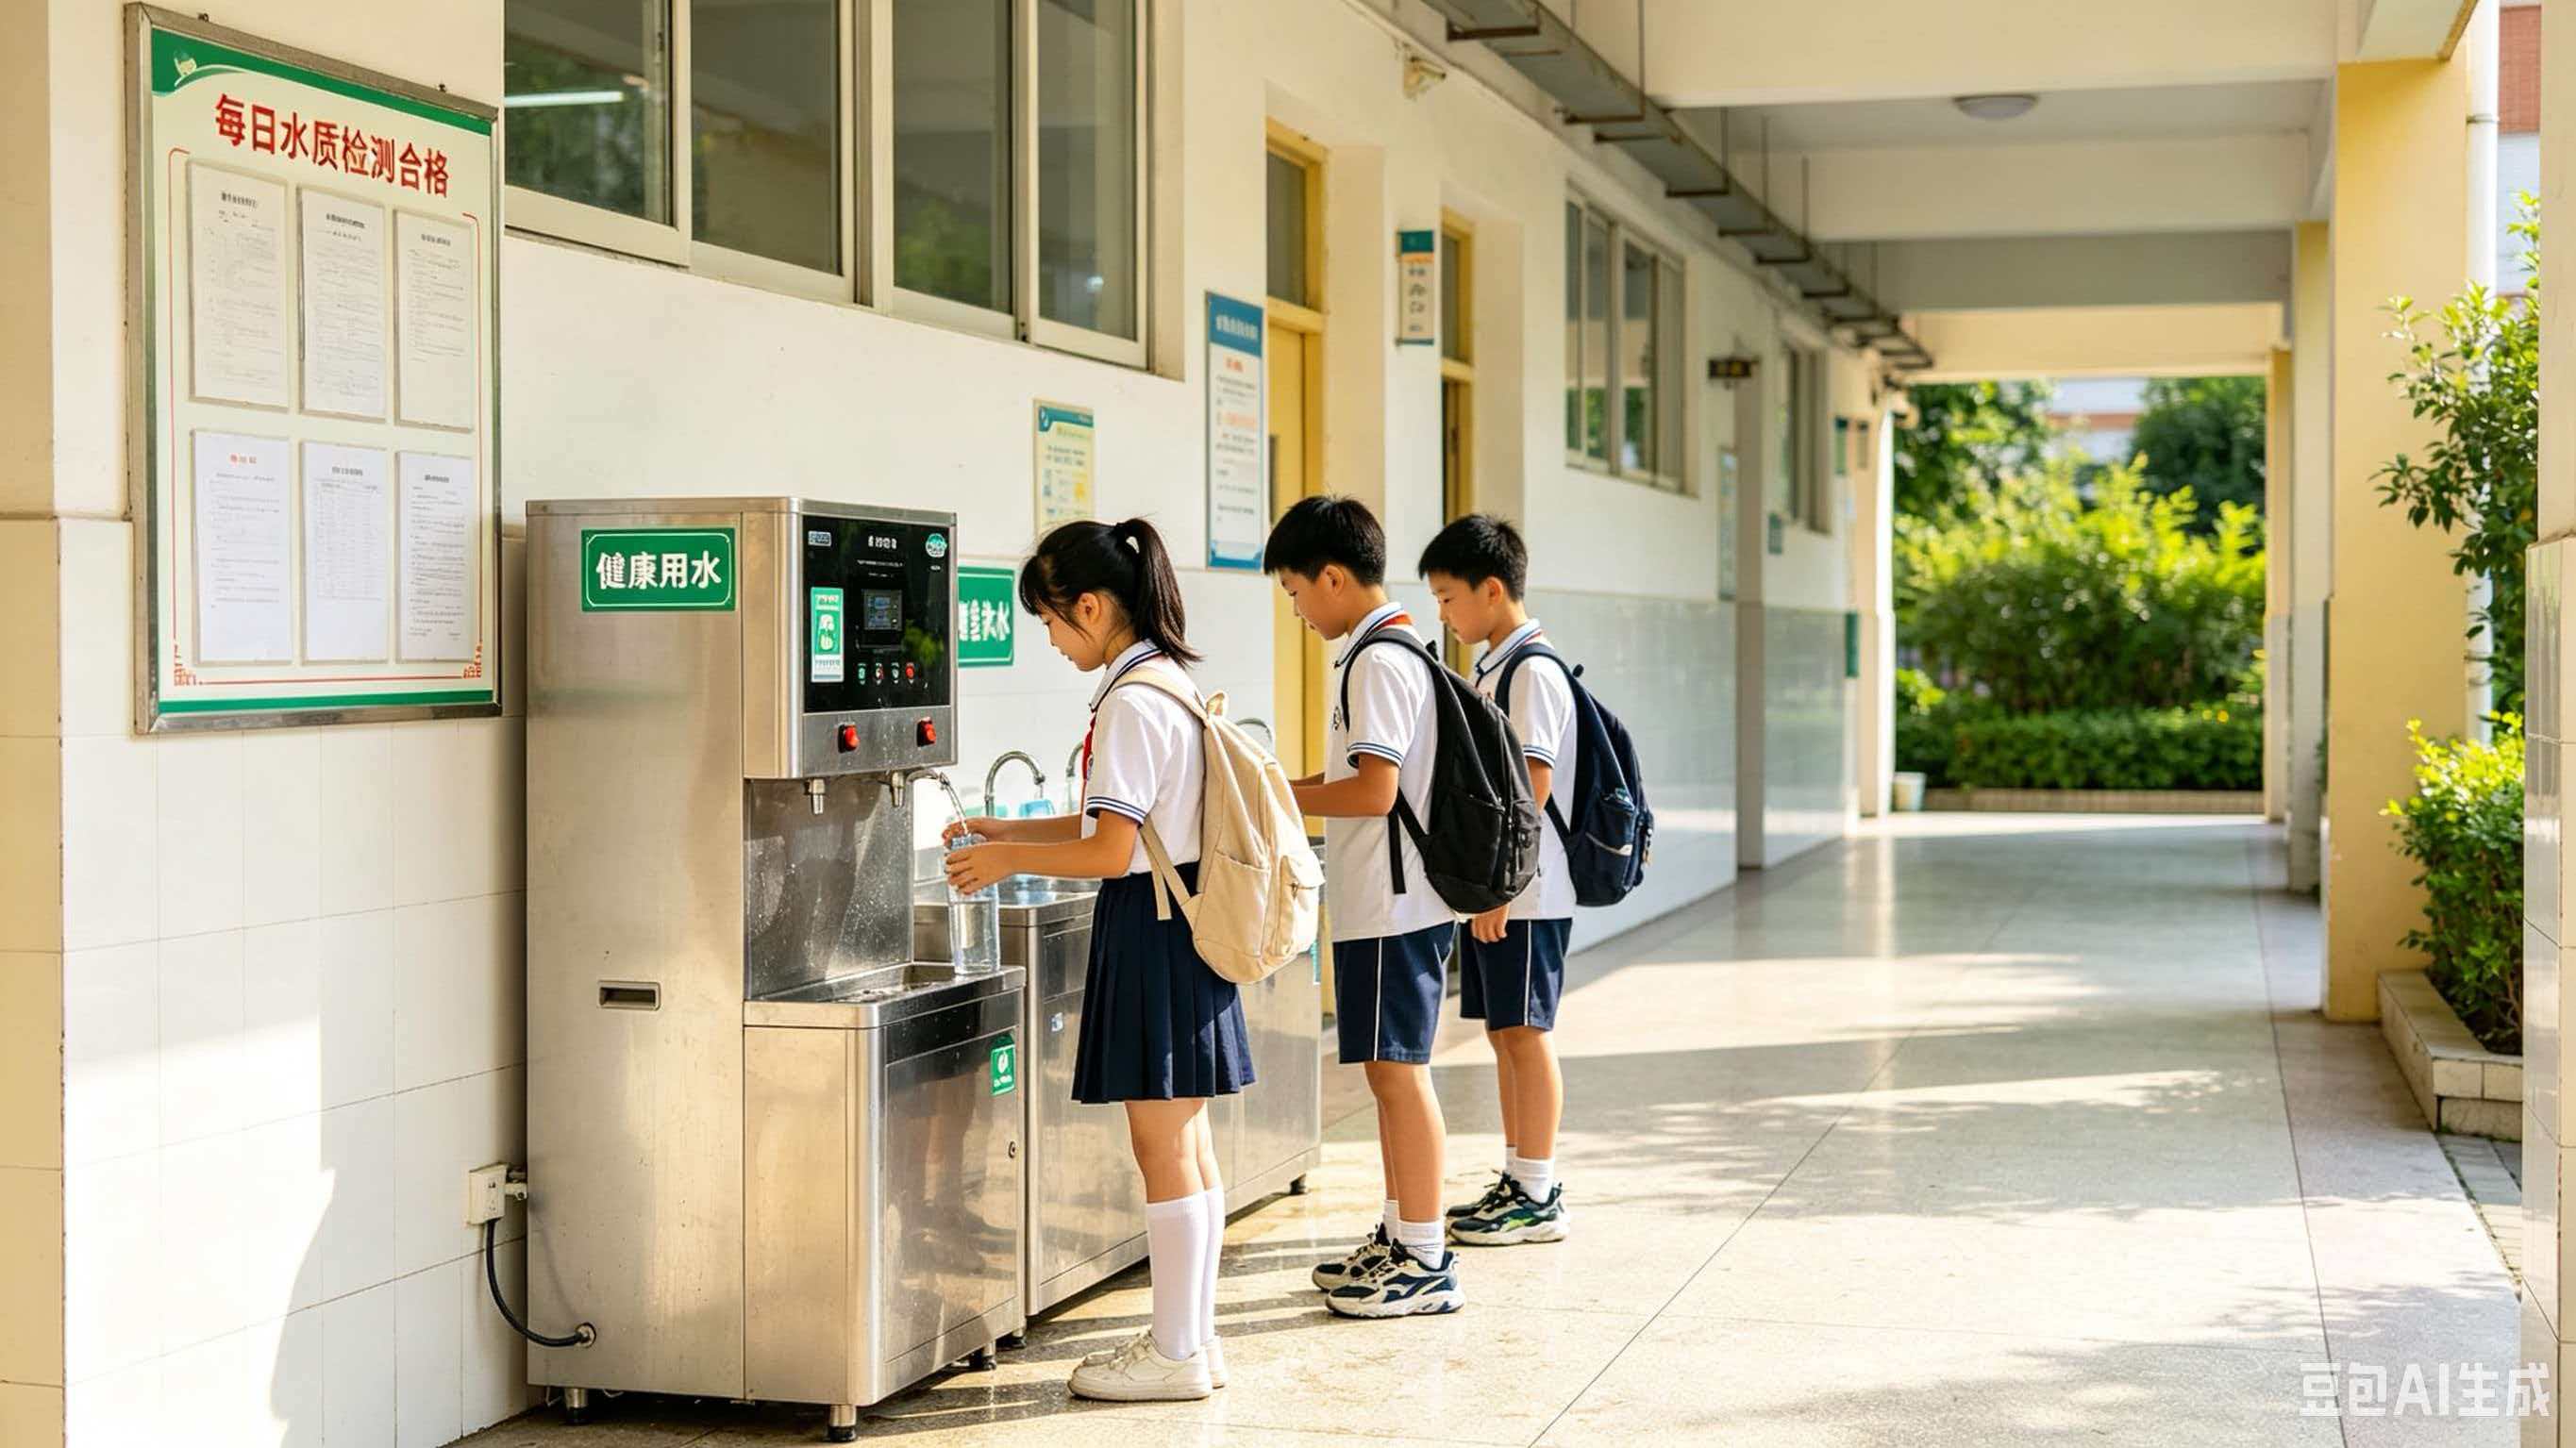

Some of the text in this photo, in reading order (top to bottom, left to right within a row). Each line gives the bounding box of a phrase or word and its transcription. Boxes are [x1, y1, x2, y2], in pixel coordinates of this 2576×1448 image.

[215, 92, 449, 198] 每日水质检测合格
[595, 550, 722, 590] 健康用水
